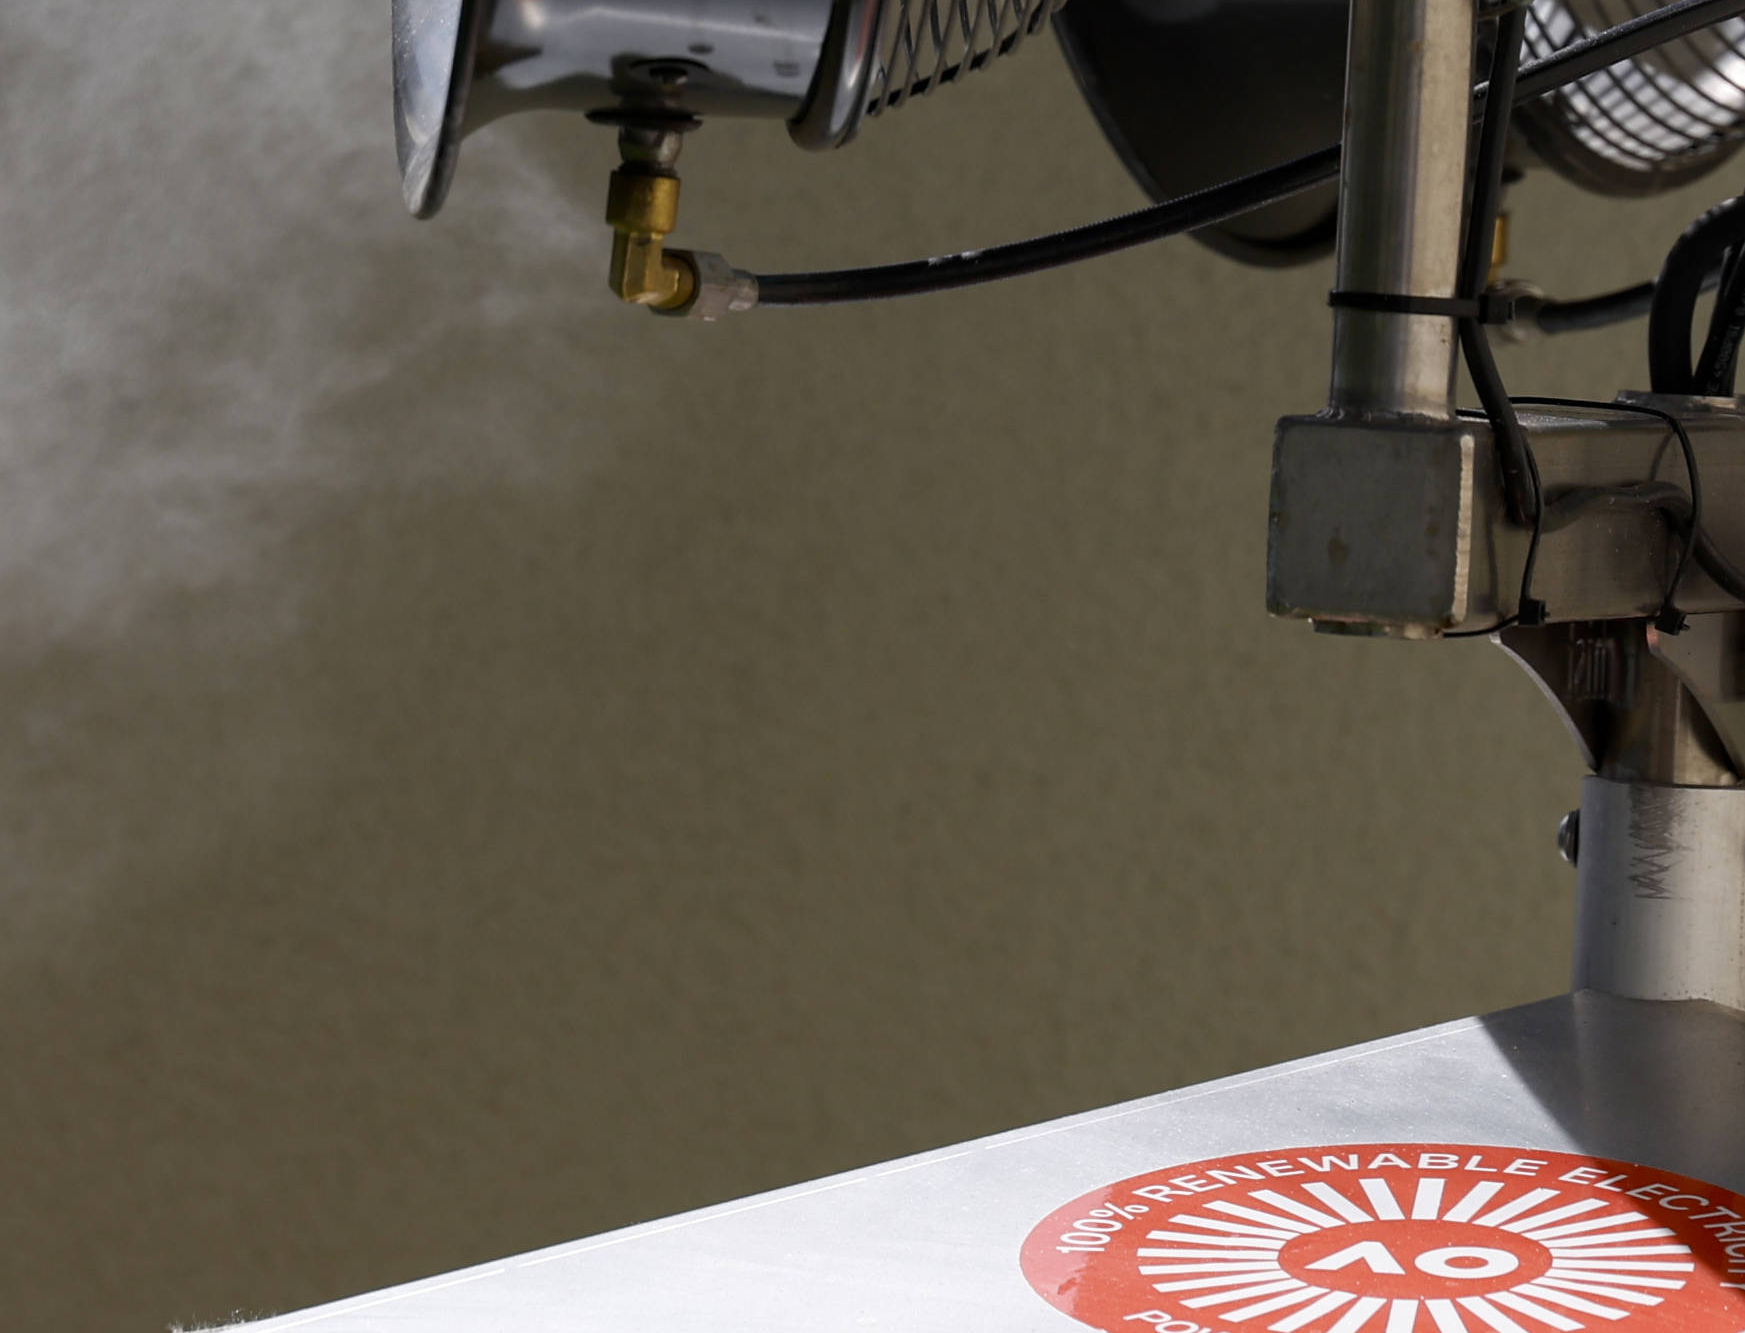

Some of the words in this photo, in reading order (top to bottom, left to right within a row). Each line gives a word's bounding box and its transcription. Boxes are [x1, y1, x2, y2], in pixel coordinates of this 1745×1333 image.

[1055, 1201, 1150, 1254] 100%
[1131, 1152, 1549, 1203] RENEWABLE
[1304, 1240, 1519, 1279] AO
[1122, 1309, 1231, 1333] PO
